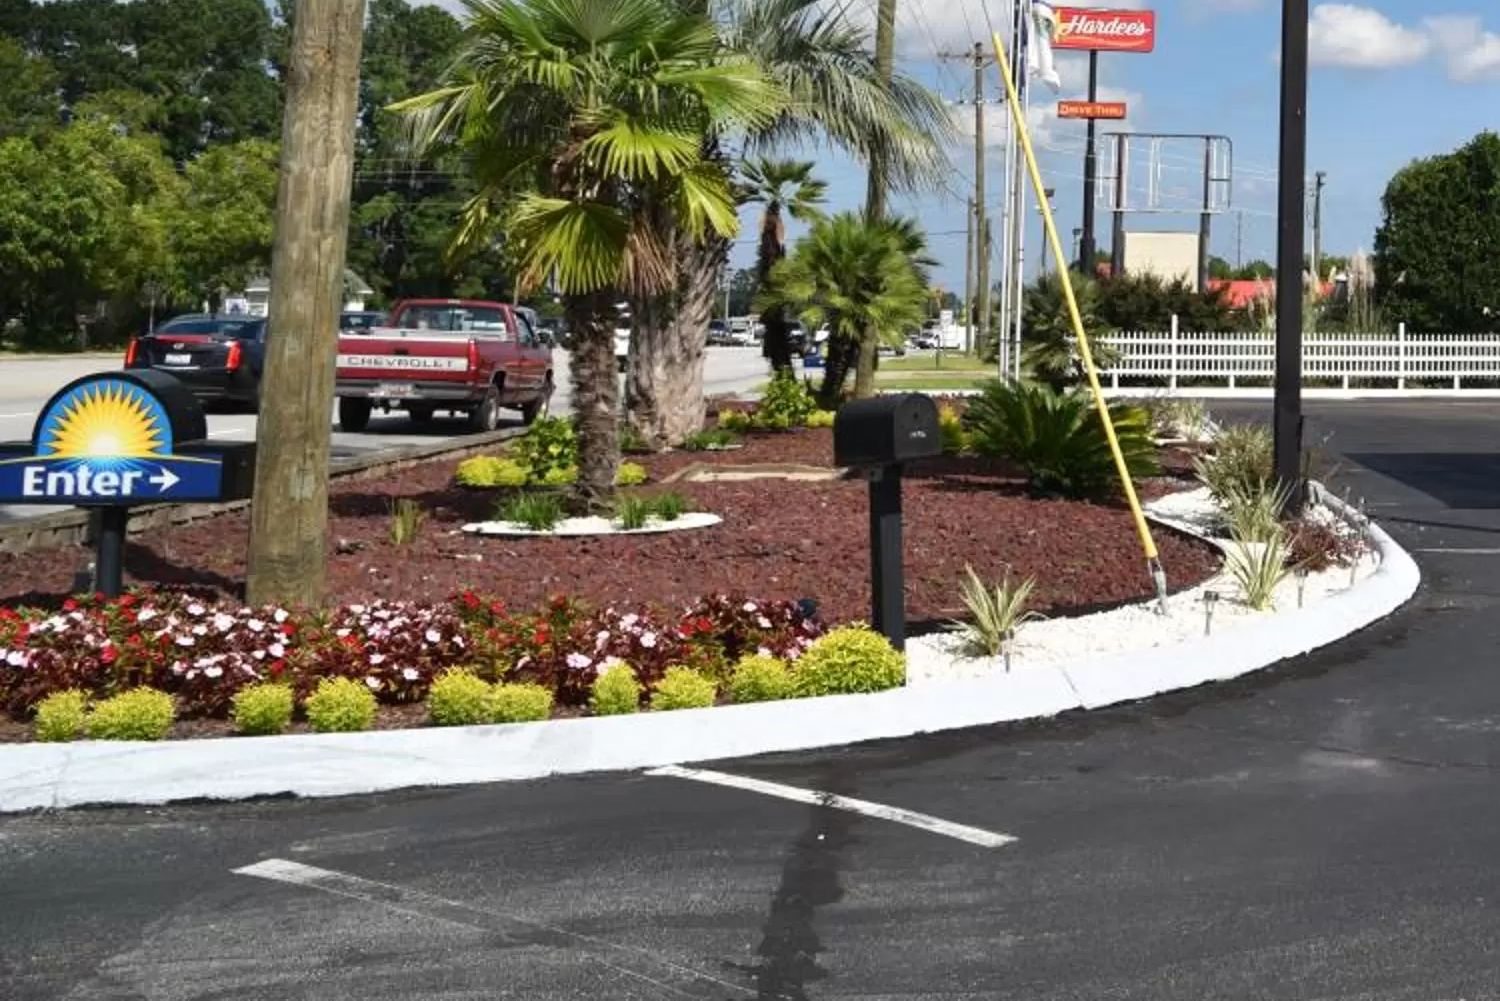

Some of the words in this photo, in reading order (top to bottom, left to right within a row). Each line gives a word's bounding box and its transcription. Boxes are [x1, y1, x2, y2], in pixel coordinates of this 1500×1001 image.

[1060, 15, 1150, 36] Hardee's
[347, 357, 453, 369] CHEVROLET
[22, 464, 144, 497] Enter
